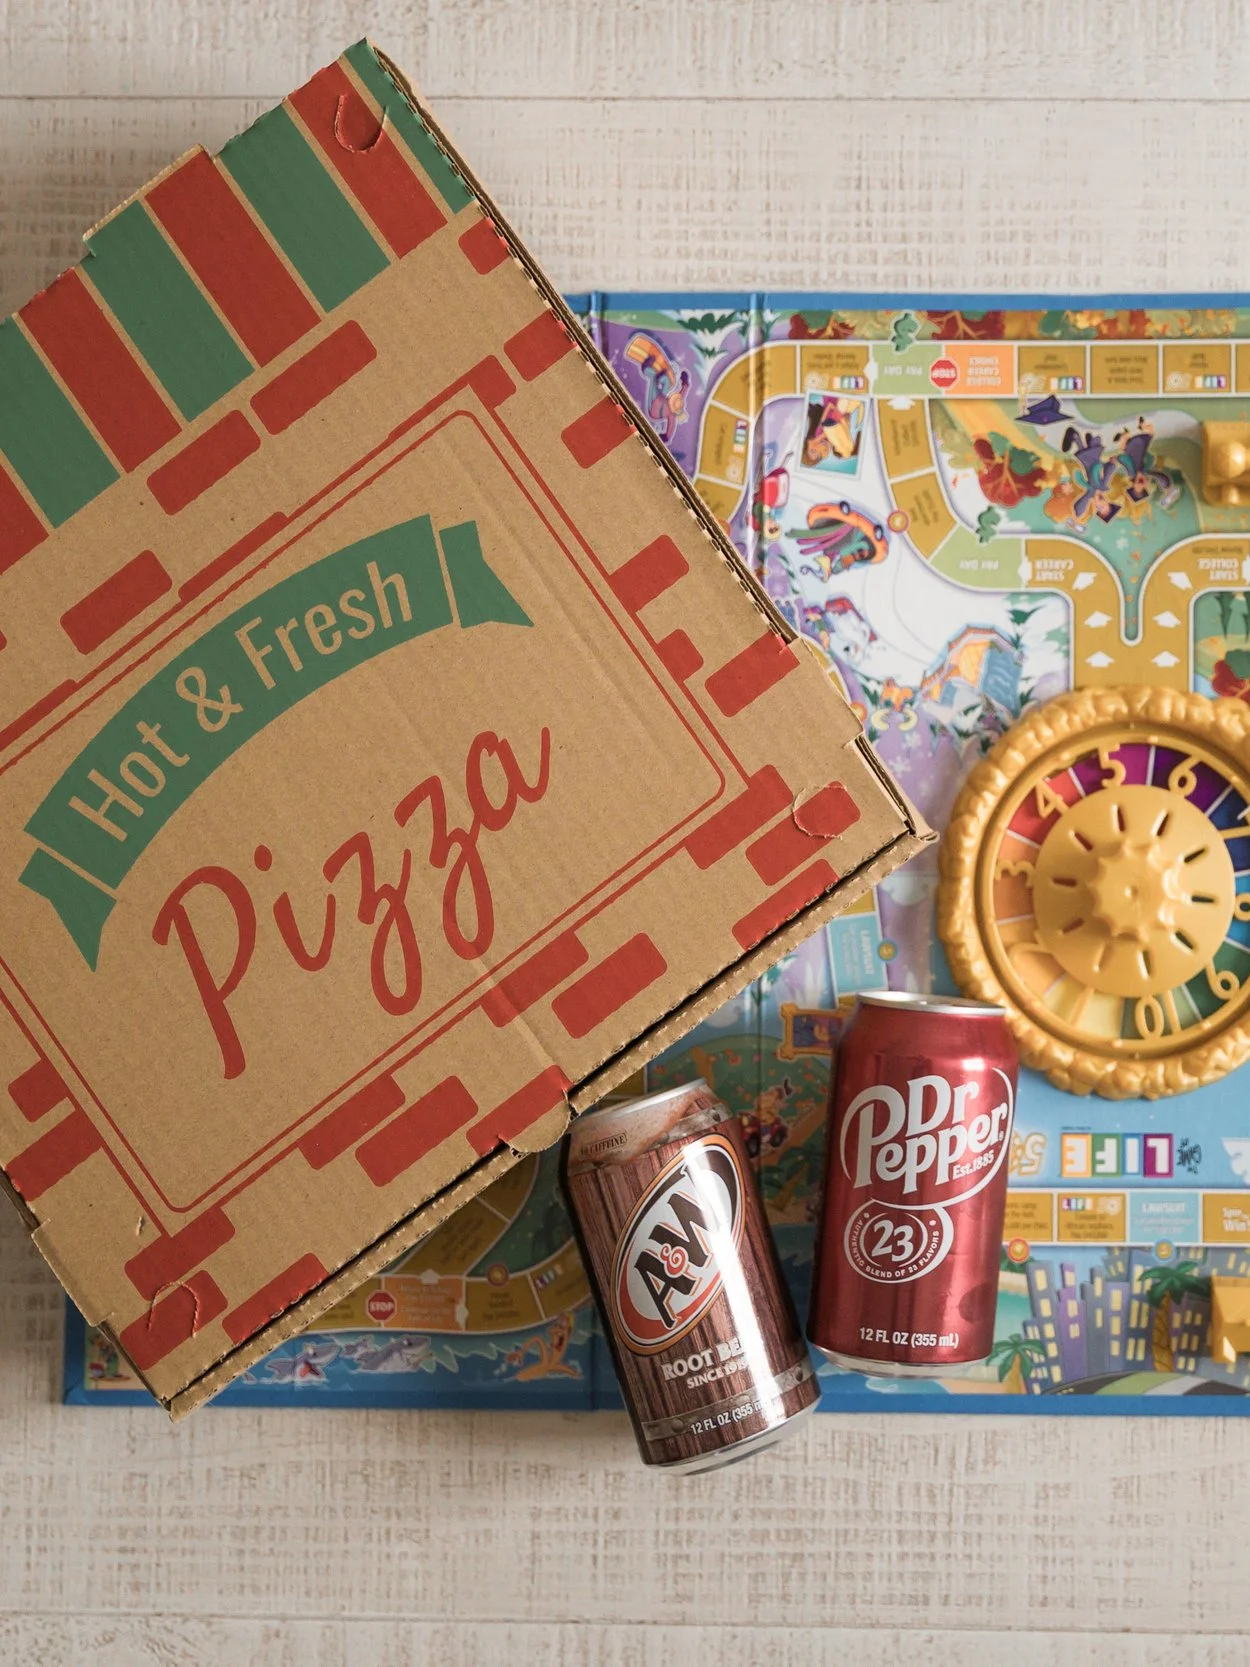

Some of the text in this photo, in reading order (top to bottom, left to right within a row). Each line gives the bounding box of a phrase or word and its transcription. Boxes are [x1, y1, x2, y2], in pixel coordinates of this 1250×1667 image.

[931, 366, 957, 379] STOP
[67, 562, 413, 843] Hot & Fresh
[151, 726, 551, 1081] Pizza
[905, 1075, 980, 1138] Dr
[588, 1134, 627, 1155] CAFFEINE
[840, 1084, 1009, 1195] Pepper
[1063, 1135, 1172, 1177] LIFE
[850, 1218, 865, 1267] AUTHENTIC
[865, 1264, 893, 1279] BLEND
[894, 1268, 906, 1279] OF
[918, 1230, 940, 1267] FLAVORS
[871, 1218, 914, 1263] 23
[369, 1301, 395, 1312] STOP
[859, 1326, 874, 1342] 12
[875, 1329, 890, 1344] FL
[892, 1331, 909, 1346] OZ
[910, 1332, 937, 1349] (355
[660, 1347, 715, 1382] ROOT
[685, 1366, 725, 1390] SINCE
[690, 1422, 703, 1436] 12
[703, 1417, 717, 1432] FL
[717, 1411, 731, 1427] OZ
[731, 1402, 754, 1425] (355
